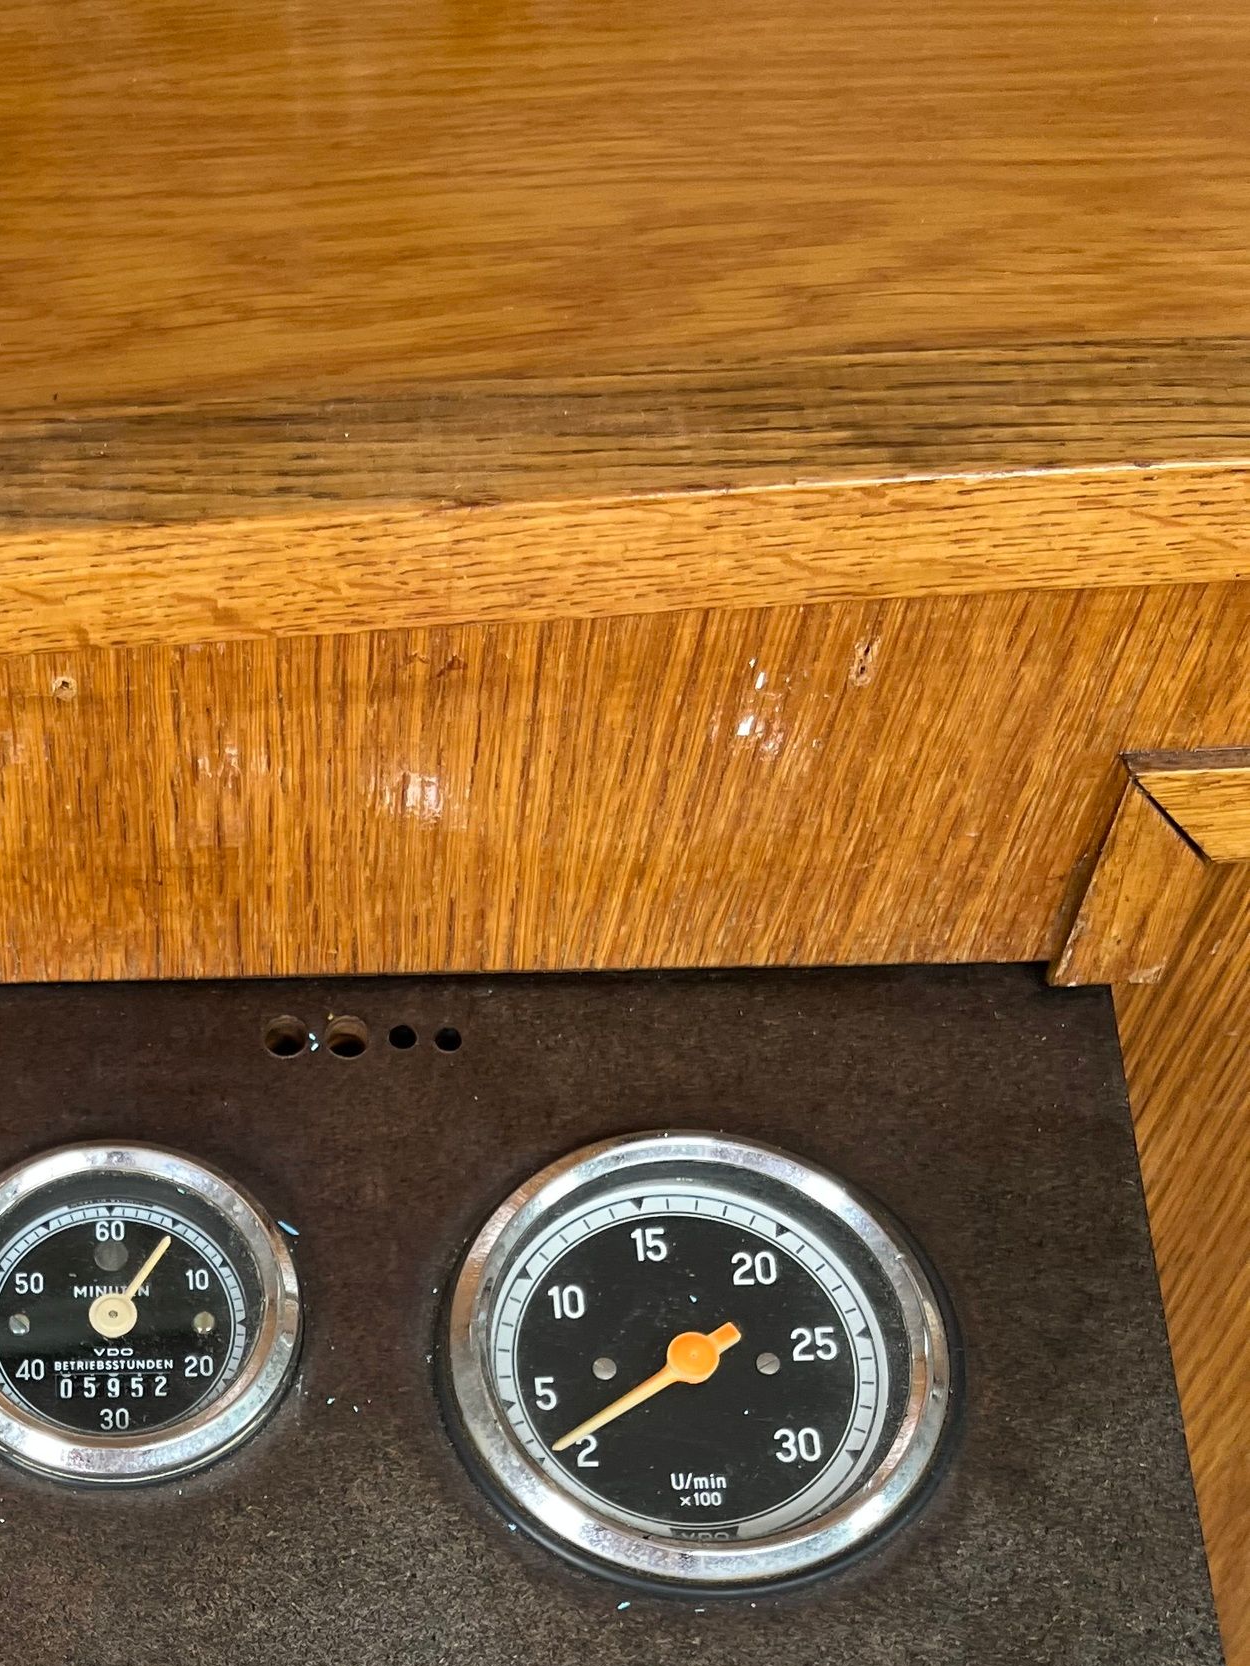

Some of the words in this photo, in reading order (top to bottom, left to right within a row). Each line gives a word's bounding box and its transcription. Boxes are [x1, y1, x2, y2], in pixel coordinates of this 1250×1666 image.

[95, 1221, 124, 1242] 60
[630, 1227, 668, 1262] 15
[185, 1269, 210, 1291] 10
[731, 1251, 777, 1286] 20
[15, 1272, 44, 1294] 50
[73, 1285, 150, 1299] MINUTN
[547, 1285, 586, 1320] 10
[93, 1347, 134, 1357] VDO
[791, 1327, 837, 1362] 25
[15, 1358, 45, 1381] 40
[54, 1357, 174, 1372] BETRIEBSSTUNDEN
[184, 1355, 214, 1377] 20
[534, 1375, 558, 1411] 5
[99, 1408, 130, 1431] 30
[576, 1436, 600, 1468] 2
[773, 1427, 822, 1463] 30
[670, 1472, 727, 1491] U/min
